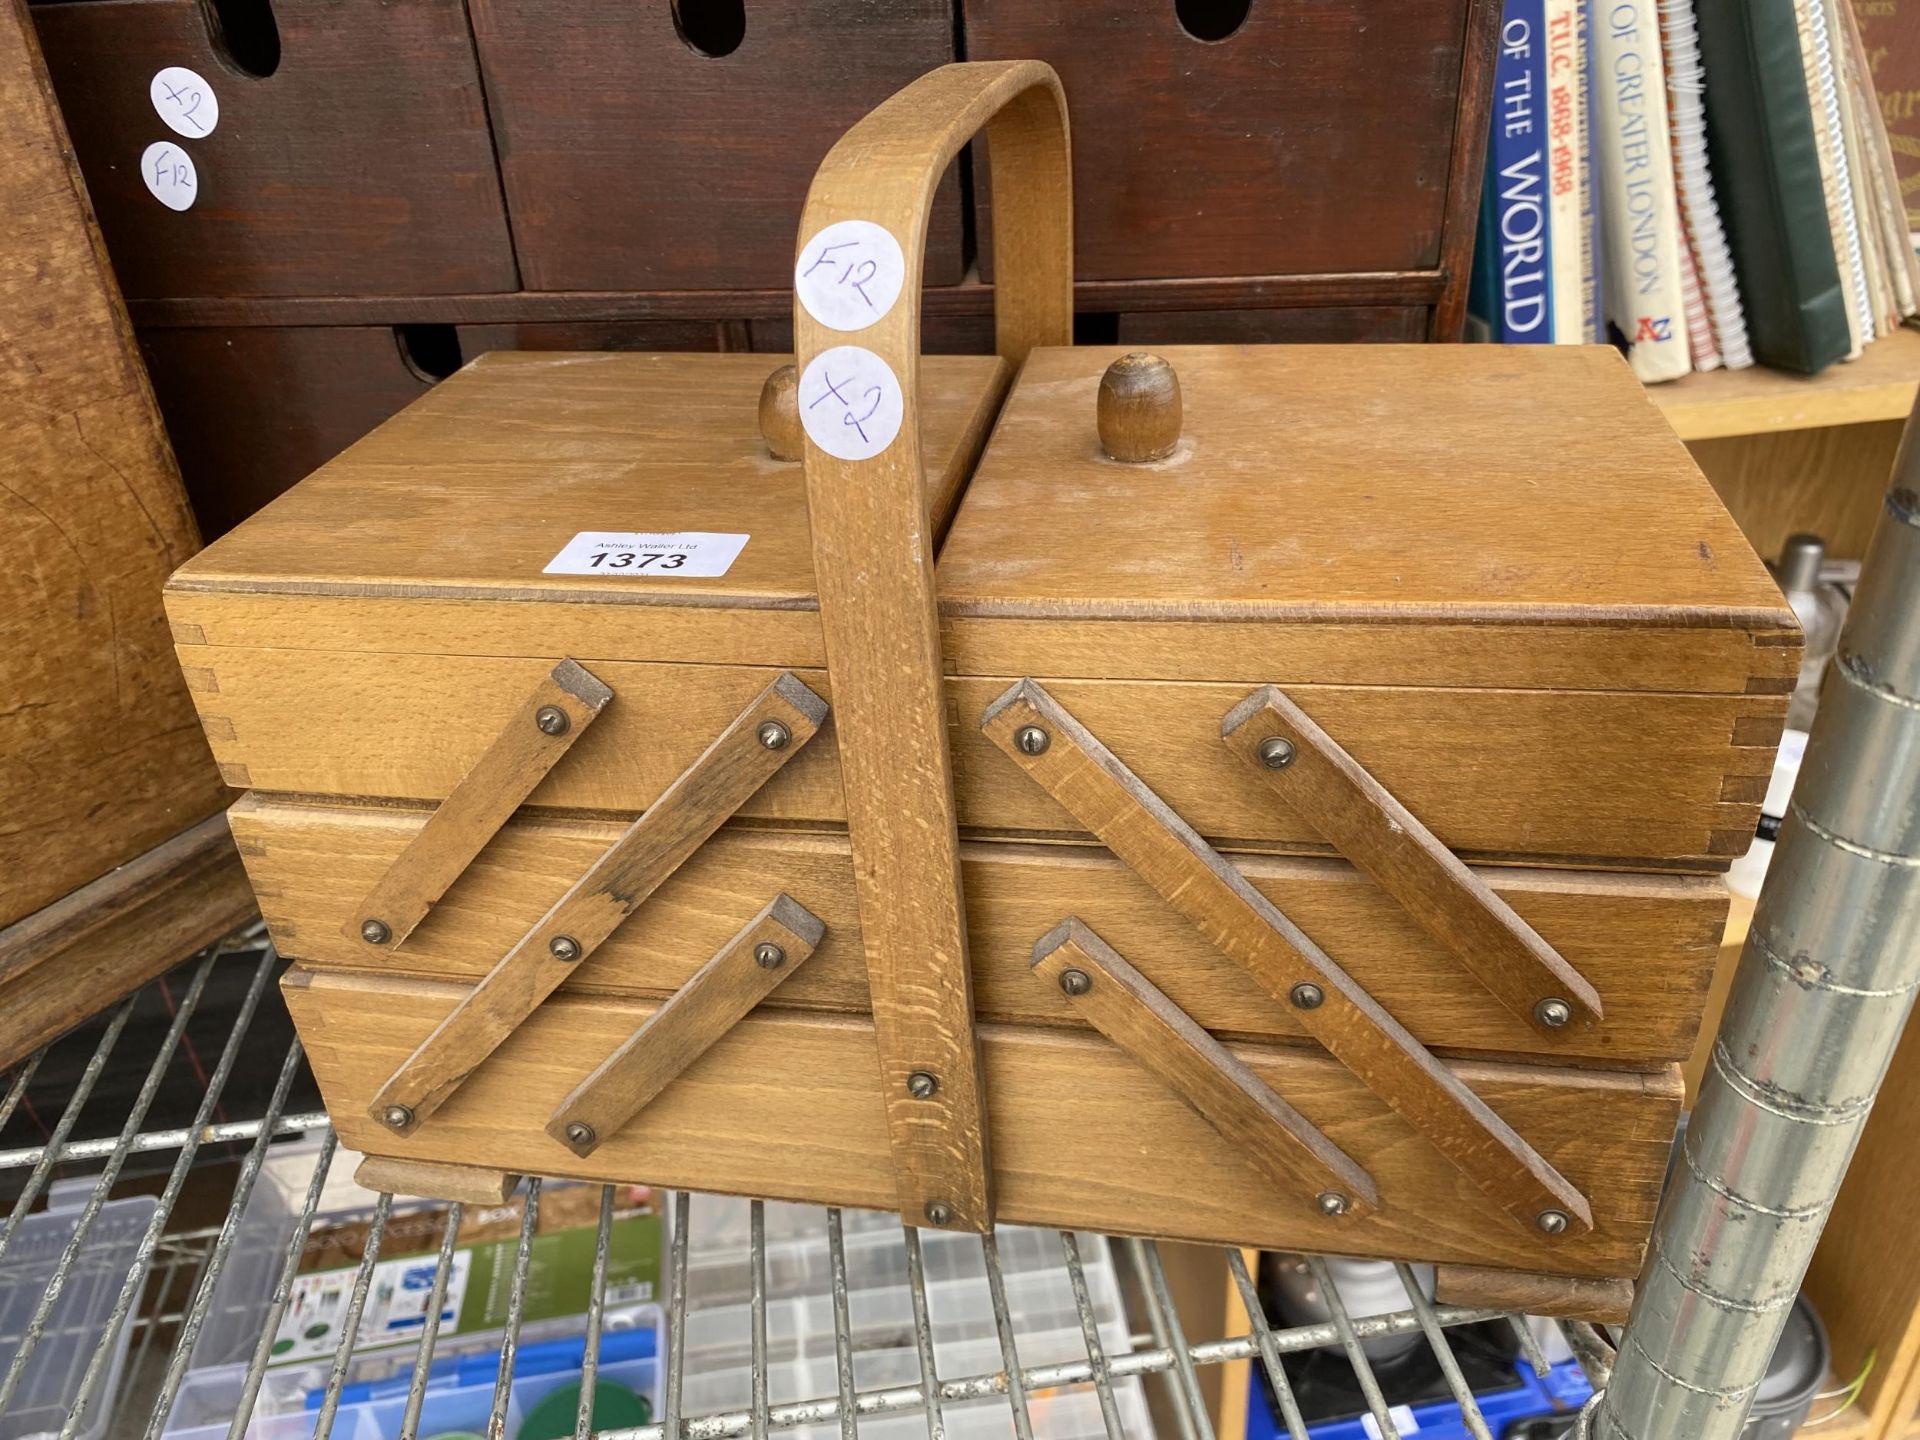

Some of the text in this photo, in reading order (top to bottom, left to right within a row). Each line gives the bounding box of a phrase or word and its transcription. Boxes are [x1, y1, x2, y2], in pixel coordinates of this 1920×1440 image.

[154, 150, 192, 187] F12
[1500, 18, 1546, 333] OF THE WORLD
[1609, 4, 1660, 295] OF GREATER LONDON
[803, 241, 879, 314] F12
[589, 552, 688, 569] 1373
[594, 542, 634, 550] Ashley
[678, 543, 698, 551] Ltd
